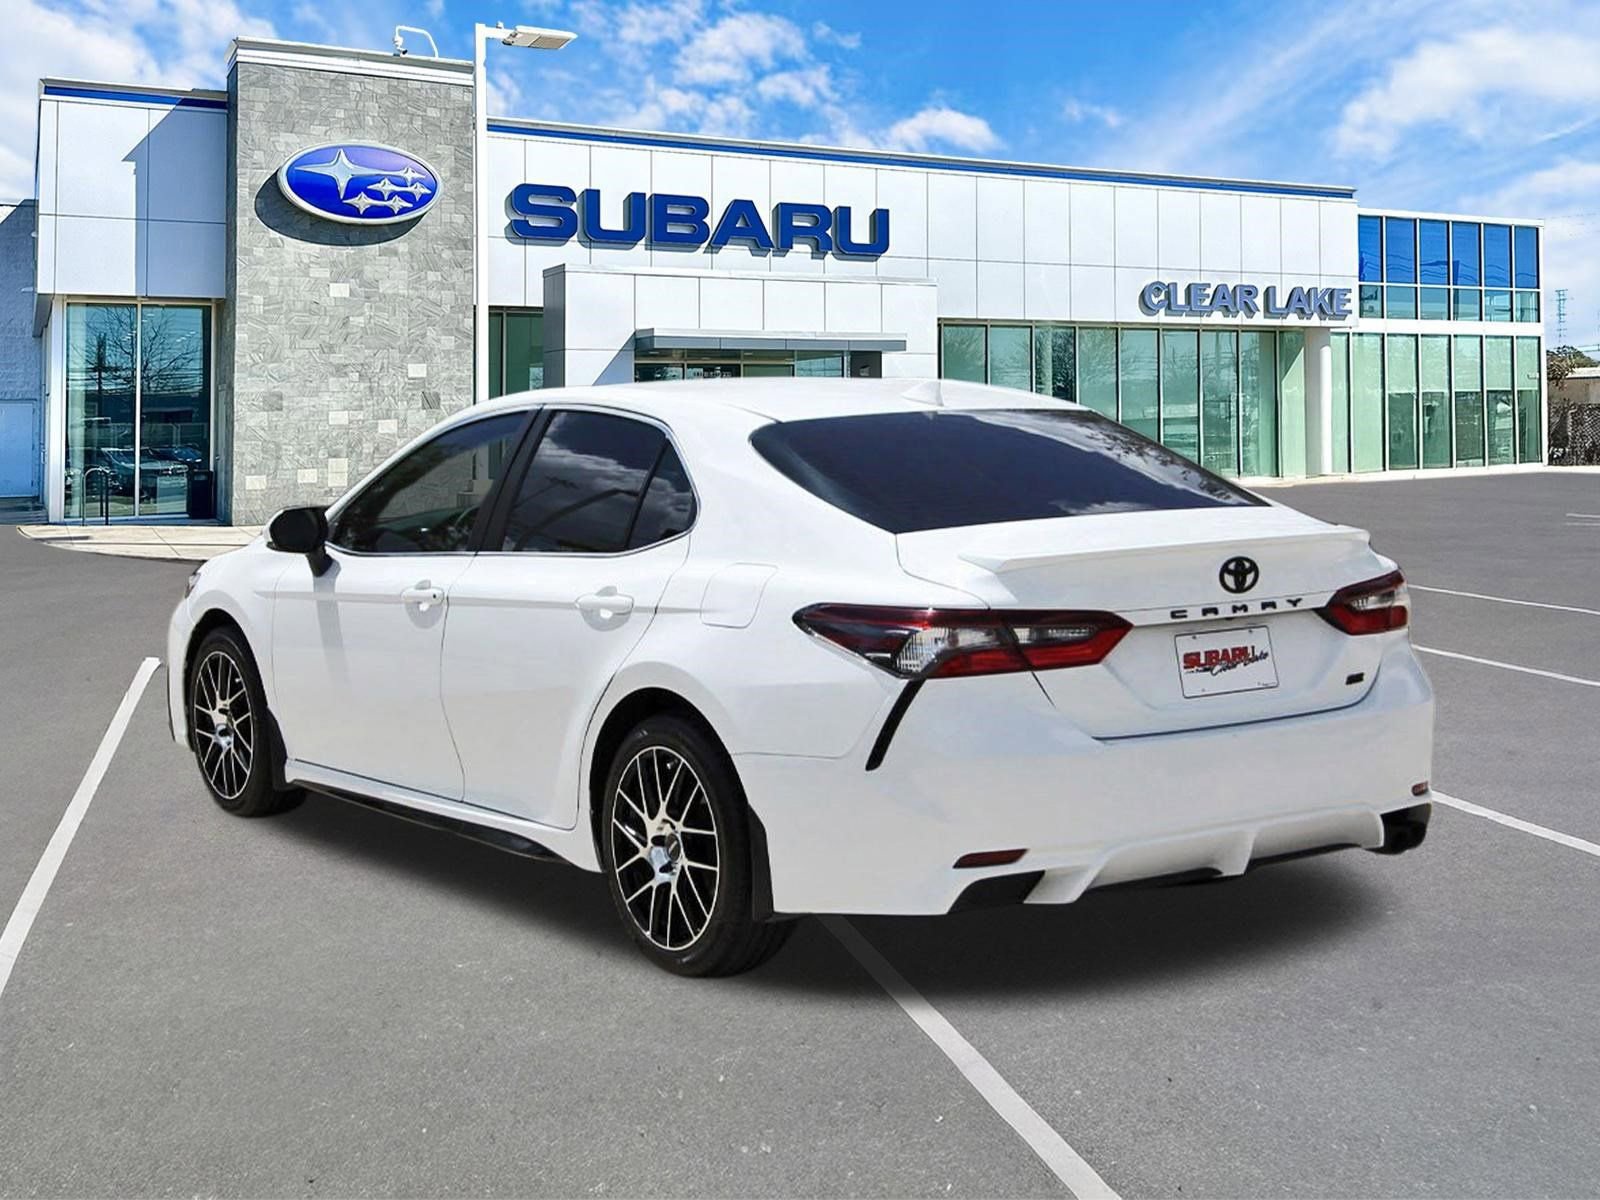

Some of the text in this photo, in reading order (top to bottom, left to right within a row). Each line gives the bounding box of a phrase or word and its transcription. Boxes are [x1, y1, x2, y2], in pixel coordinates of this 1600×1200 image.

[506, 183, 890, 259] SUBARU
[1140, 281, 1352, 320] CLEAR LAKE
[1170, 598, 1302, 619] CAMRY
[1183, 645, 1255, 670] SUBARU
